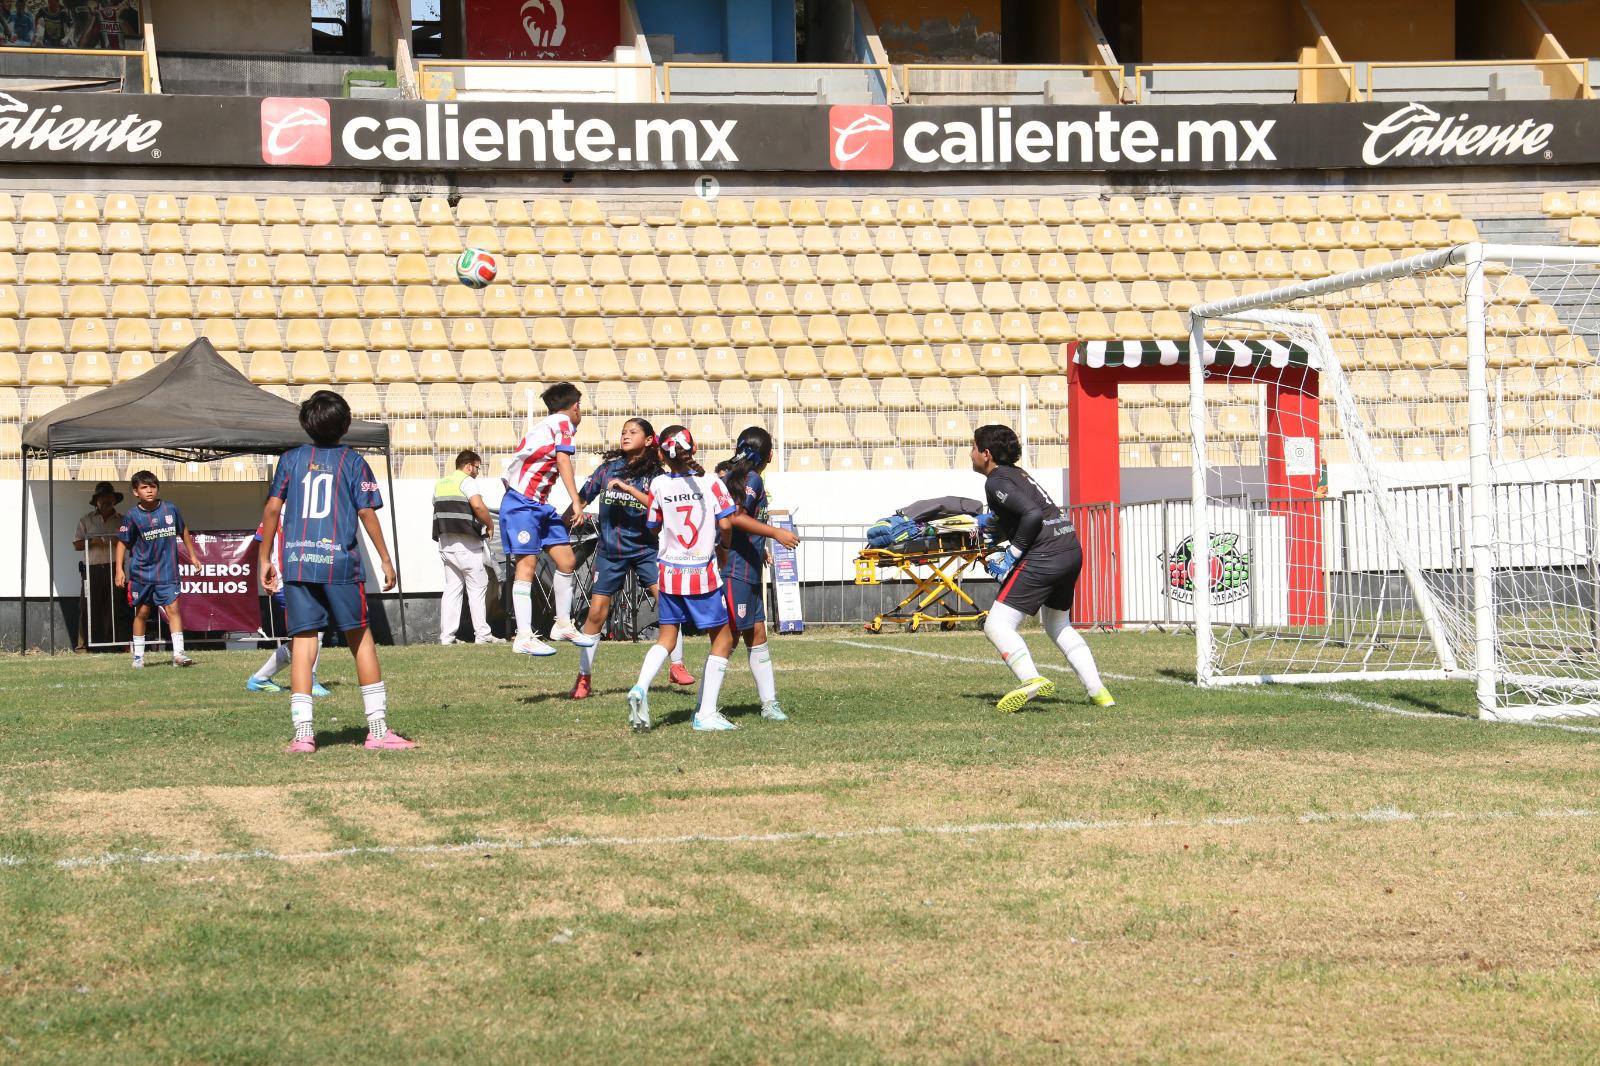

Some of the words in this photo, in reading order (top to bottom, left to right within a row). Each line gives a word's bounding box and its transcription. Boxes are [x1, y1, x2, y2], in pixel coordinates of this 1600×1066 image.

[341, 104, 739, 162] caliente.mx
[903, 107, 1277, 163] caliente.mx
[1362, 102, 1554, 165] Caliente
[701, 178, 712, 196] F
[302, 471, 333, 519] 10
[676, 505, 698, 549] 3
[178, 563, 250, 577] RIMEROS
[180, 581, 248, 594] UXILIOS
